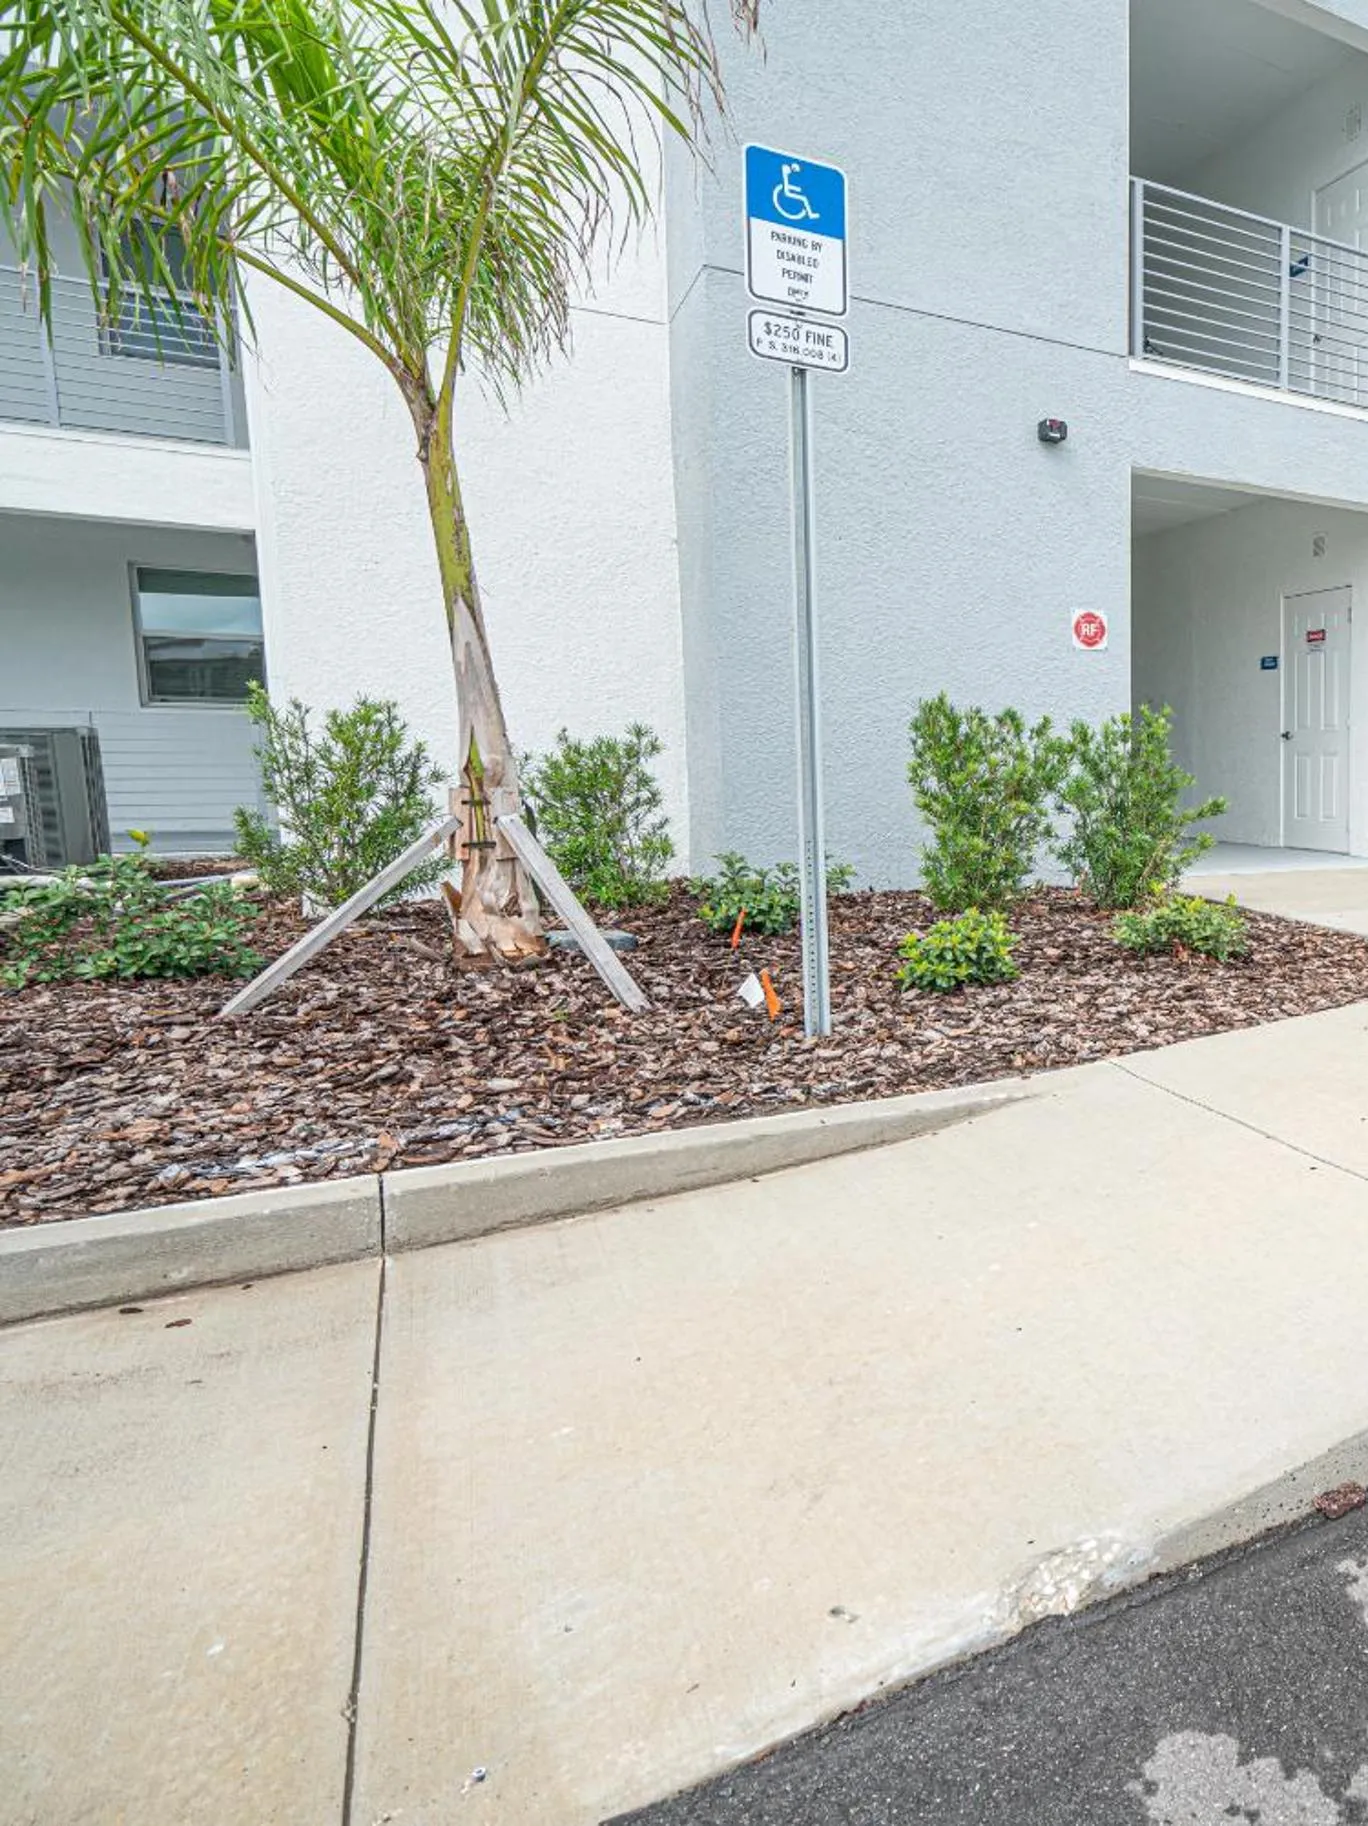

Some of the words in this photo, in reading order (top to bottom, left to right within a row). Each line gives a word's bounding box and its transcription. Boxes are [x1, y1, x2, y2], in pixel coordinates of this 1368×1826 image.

[771, 231, 809, 249] PARKING
[811, 240, 822, 252] BY
[776, 249, 820, 269] DISABLED
[764, 321, 800, 341] $250
[805, 330, 833, 348] FINE
